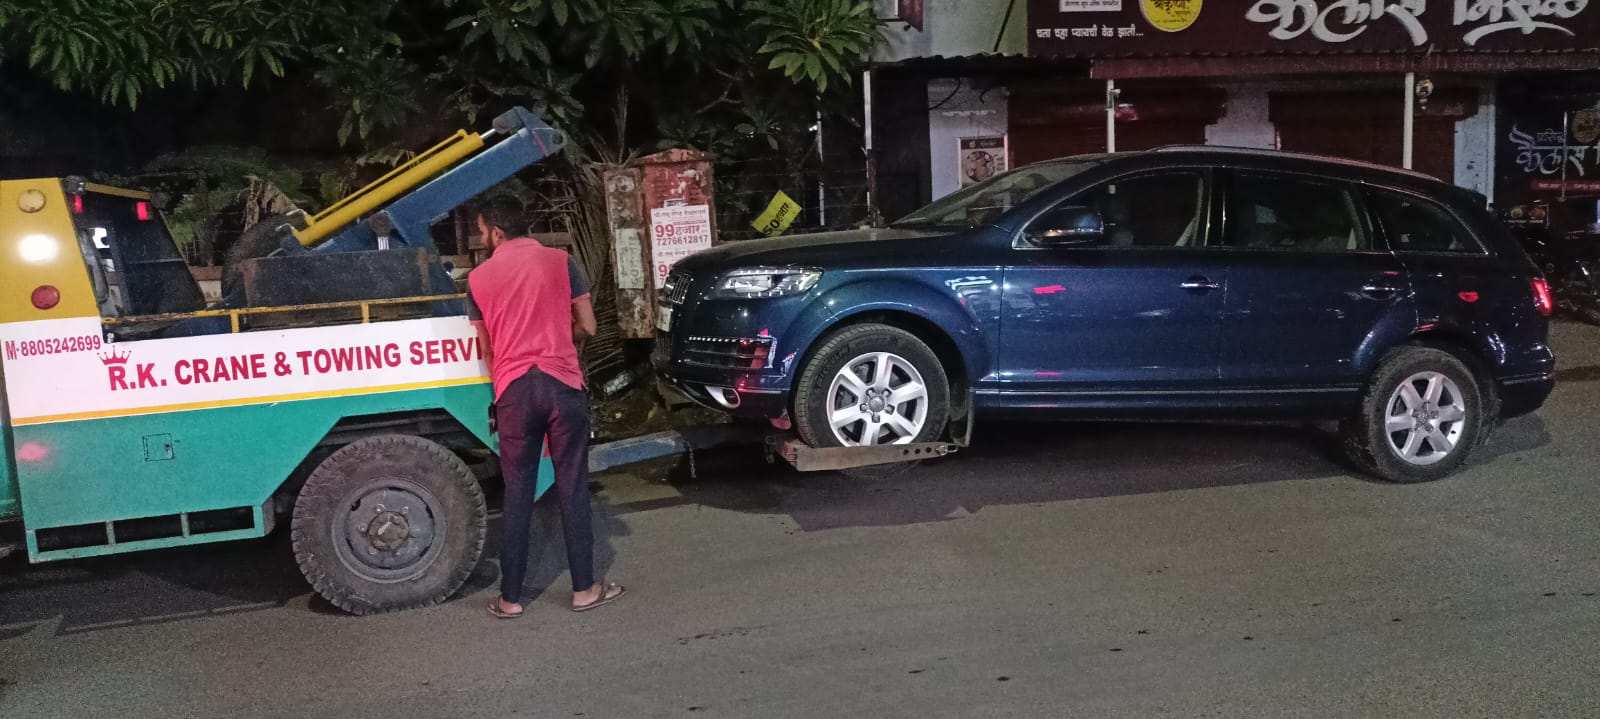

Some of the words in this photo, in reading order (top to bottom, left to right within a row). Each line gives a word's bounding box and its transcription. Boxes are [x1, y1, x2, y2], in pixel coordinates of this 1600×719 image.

[1101, 24, 1114, 38] वेळ
[1245, 0, 1428, 46] कलास
[656, 234, 709, 246] 7276612817
[107, 362, 168, 392] R.K.
[174, 353, 267, 385] CRANE
[274, 350, 293, 376] &
[296, 343, 402, 376] TOWING
